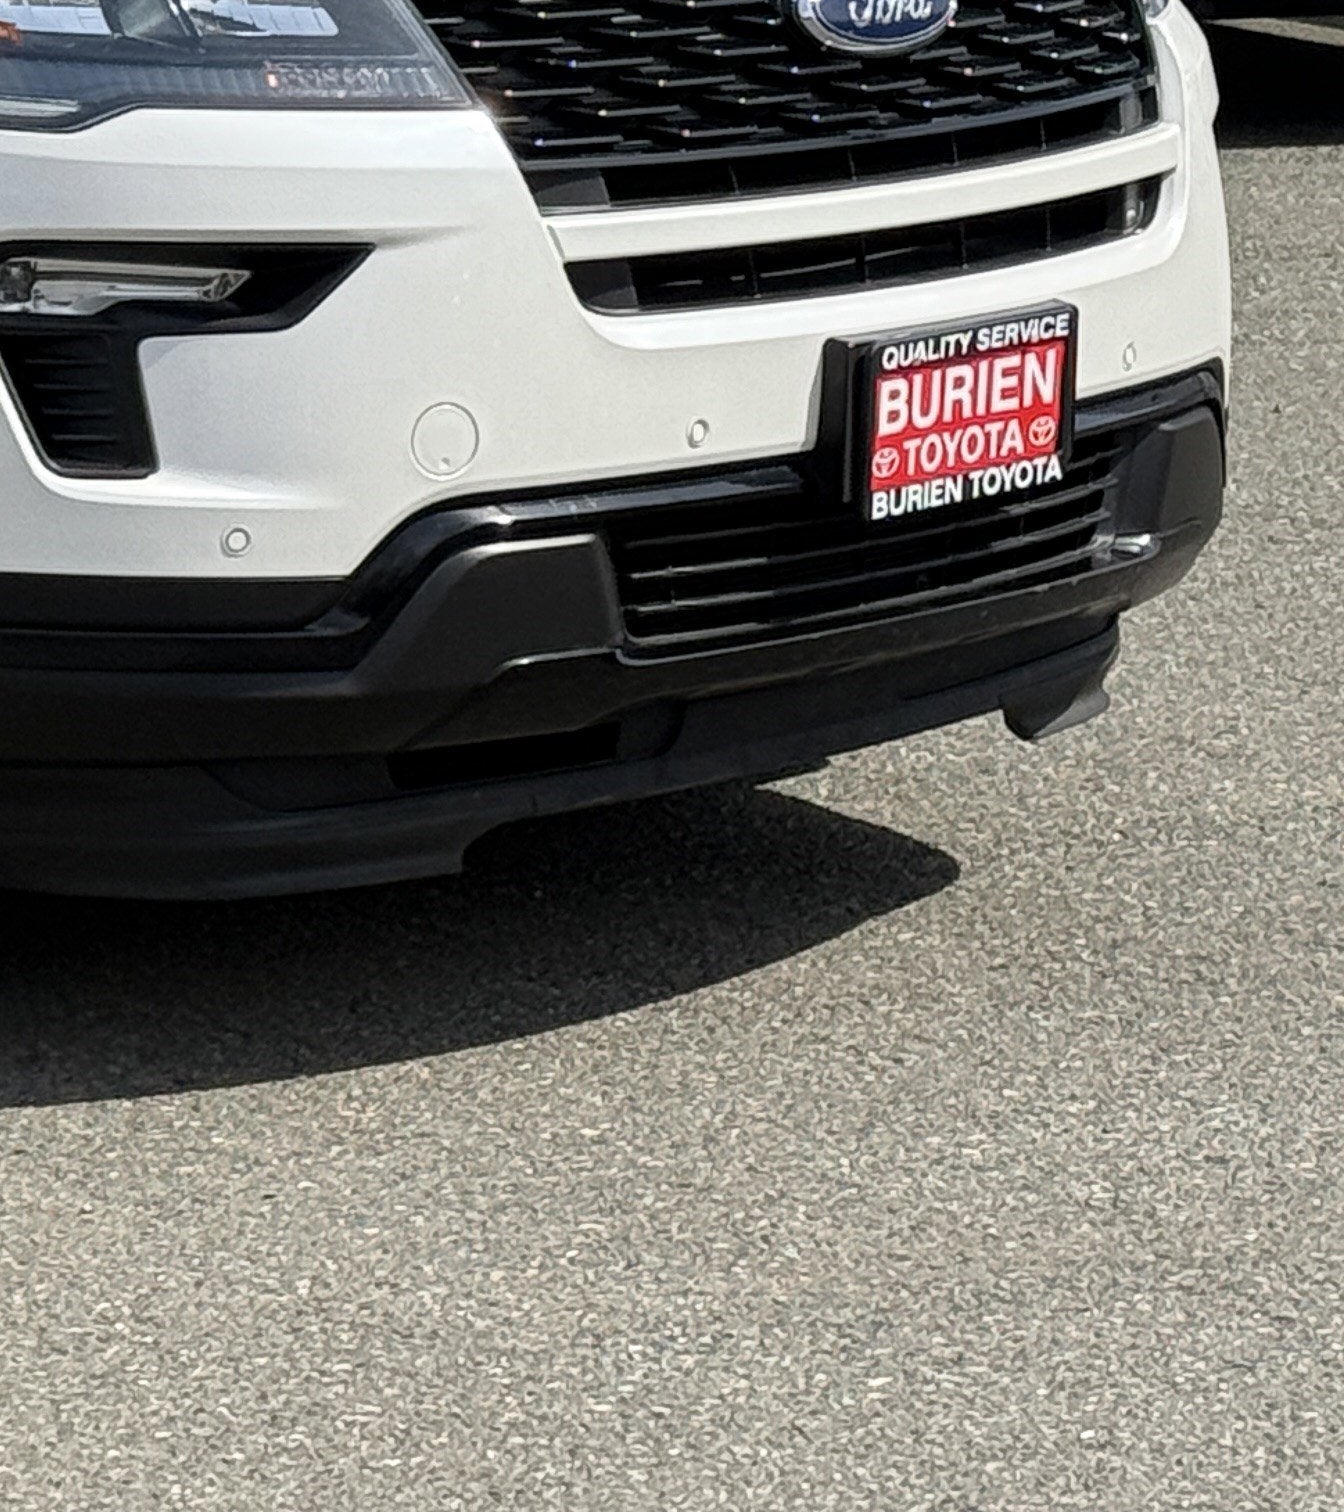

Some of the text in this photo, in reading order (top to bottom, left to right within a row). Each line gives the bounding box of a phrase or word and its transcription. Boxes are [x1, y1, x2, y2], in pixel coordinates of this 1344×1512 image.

[882, 313, 1071, 371] QUALITY SERVICE
[878, 348, 1057, 437] BURIEN
[903, 418, 1026, 477] TOYOTA
[871, 454, 1063, 521] BURIEN TOYOTA
